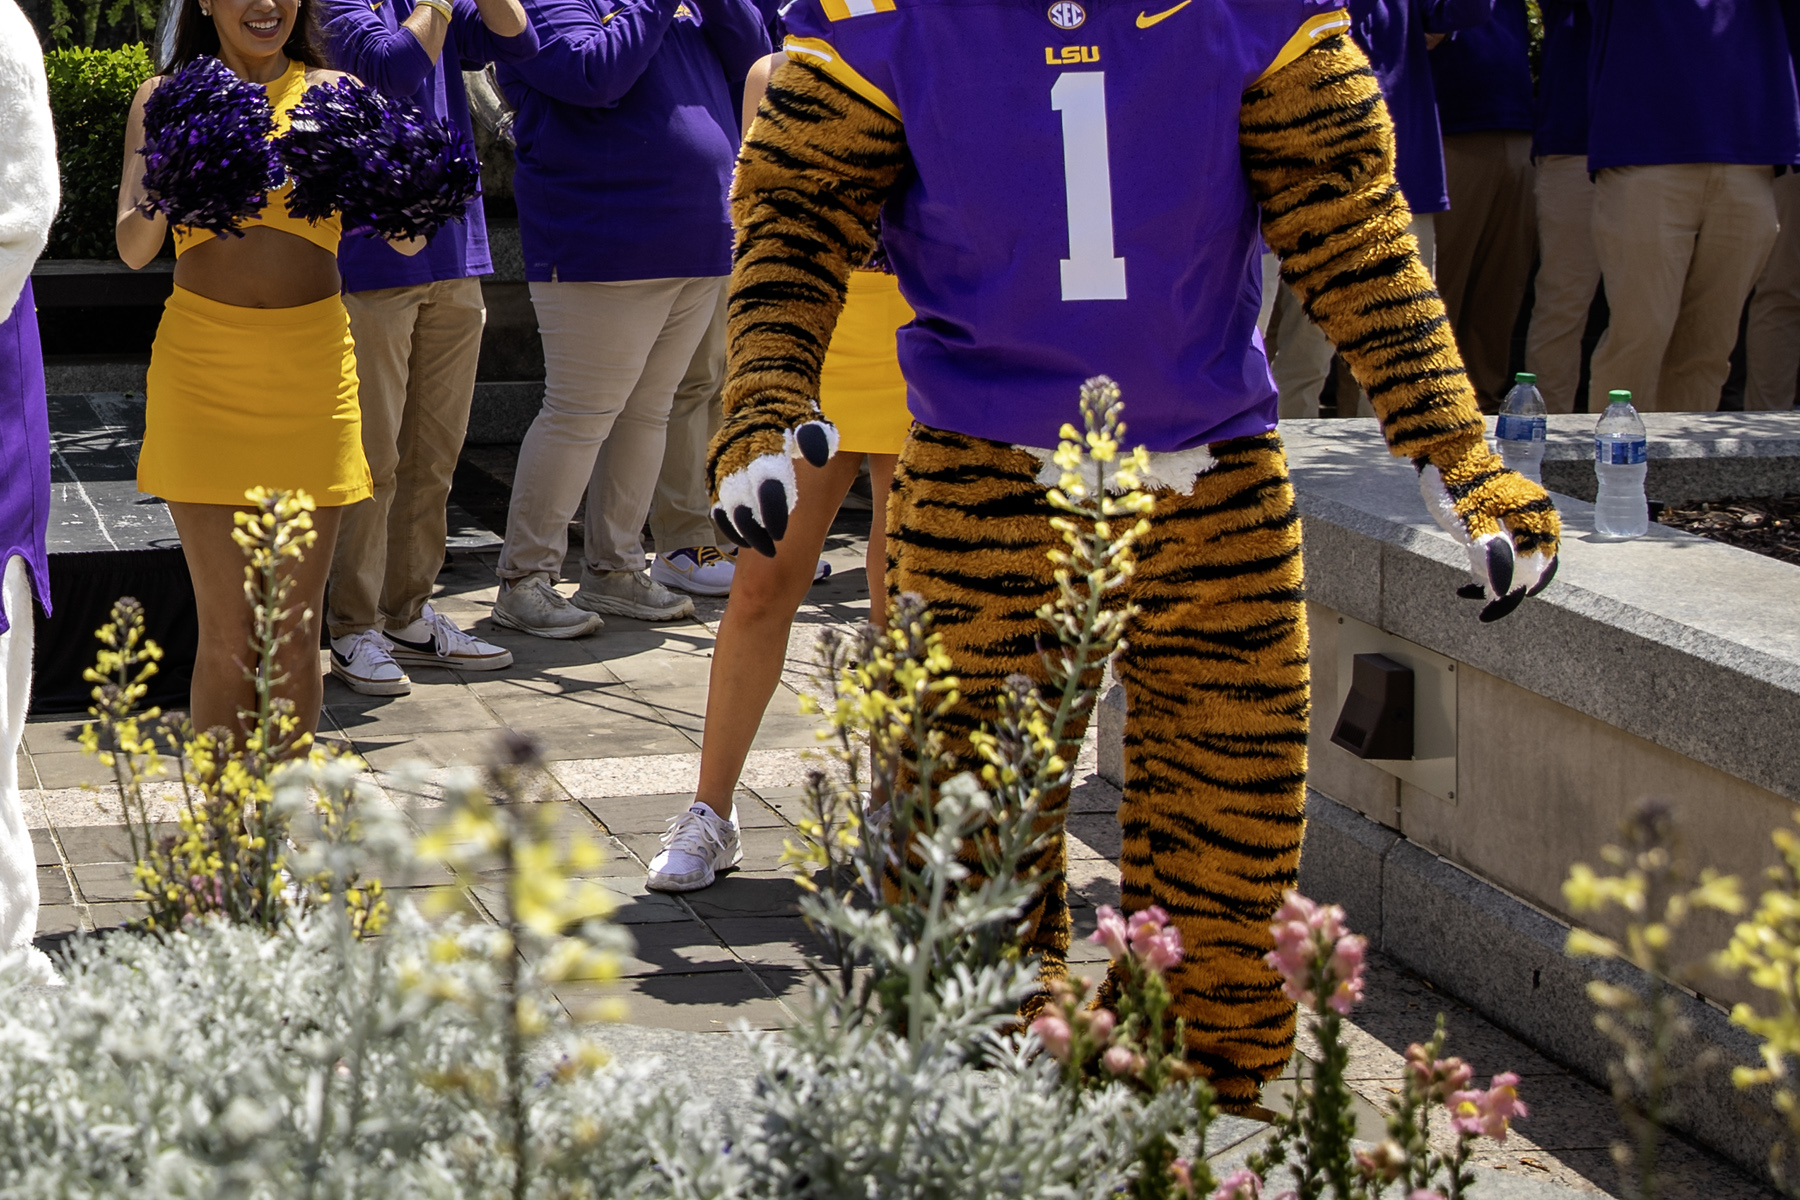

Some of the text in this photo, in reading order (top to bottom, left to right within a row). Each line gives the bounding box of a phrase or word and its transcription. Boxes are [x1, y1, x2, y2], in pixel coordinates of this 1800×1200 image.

[1051, 3, 1082, 27] SEC
[1045, 46, 1100, 64] LSU
[1050, 71, 1128, 302] 1
